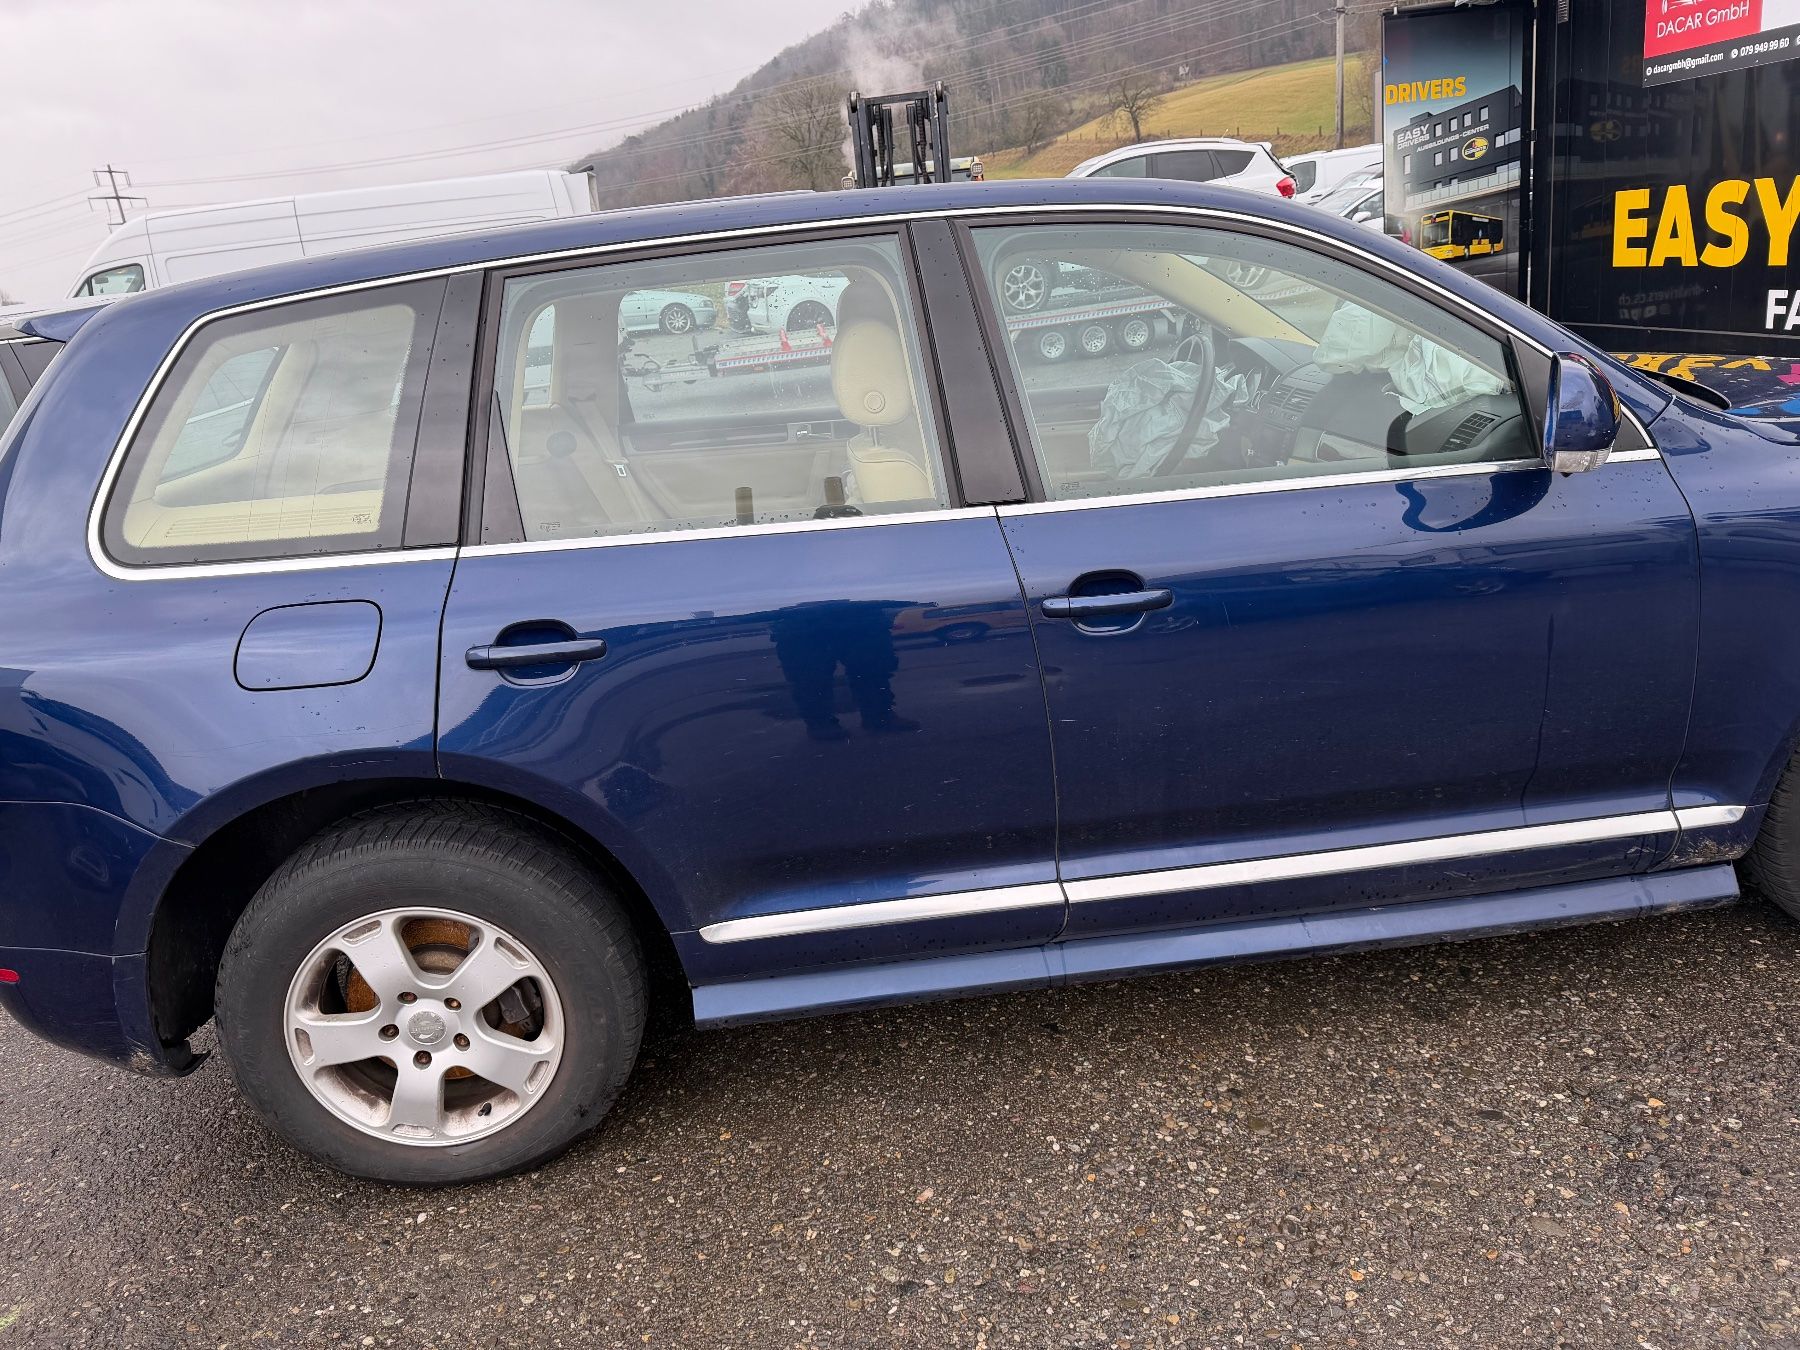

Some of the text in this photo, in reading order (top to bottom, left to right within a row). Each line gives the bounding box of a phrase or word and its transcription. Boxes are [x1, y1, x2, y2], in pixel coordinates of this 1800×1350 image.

[1656, 0, 1750, 38] DACAR GmbH
[1653, 51, 1724, 74] dacargmbh@gmail.com
[1740, 45, 1753, 57] 079
[1754, 42, 1768, 54] 949
[1769, 40, 1779, 51] 99
[1385, 76, 1467, 105] DRIVERS
[1397, 124, 1430, 144] EASY
[1397, 133, 1430, 150] DRIVERS
[1612, 174, 1800, 268] EASY
